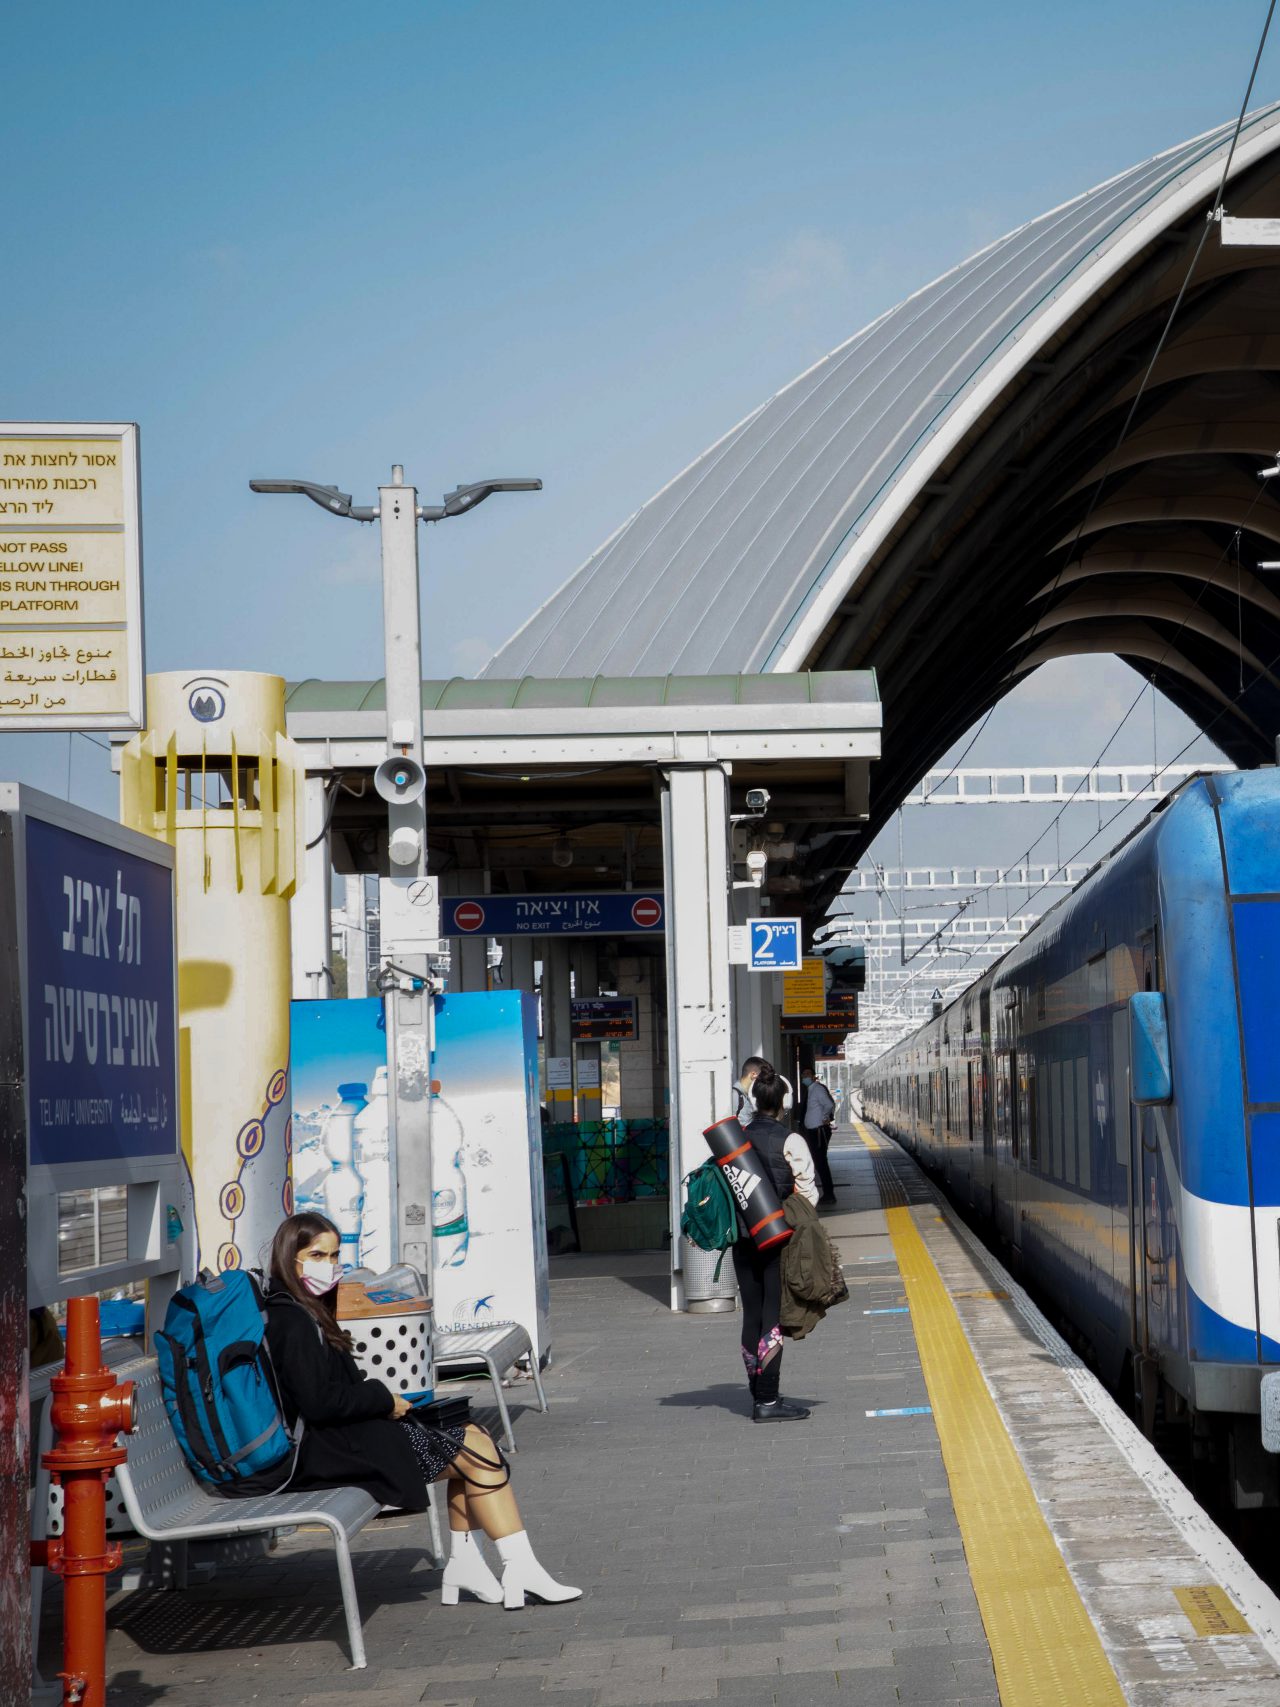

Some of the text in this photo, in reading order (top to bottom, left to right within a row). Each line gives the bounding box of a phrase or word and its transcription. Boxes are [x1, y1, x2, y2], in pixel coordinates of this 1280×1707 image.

[3, 452, 116, 466] אסור לחצות את
[53, 478, 97, 490] רכבות
[31, 499, 54, 513] ליד
[30, 543, 68, 553] PASS
[48, 562, 84, 572] LINE!
[15, 581, 46, 592] RUN
[49, 580, 120, 592] THROUGH
[0, 600, 78, 611] PLATFORM
[38, 645, 70, 662] تجاوز
[76, 649, 112, 664] ممنوع
[4, 669, 117, 685] قطارات سريعة
[44, 697, 66, 709] من
[516, 899, 600, 919] אין יציאה
[62, 870, 141, 966] תל אביב
[531, 922, 551, 930] EXIT
[772, 925, 795, 937] רציף
[754, 924, 774, 958] 2
[44, 984, 160, 1068] אוניברסיטה
[39, 1098, 113, 1126] TEL AVIV UNIVERSITY
[722, 1164, 749, 1211] adidas
